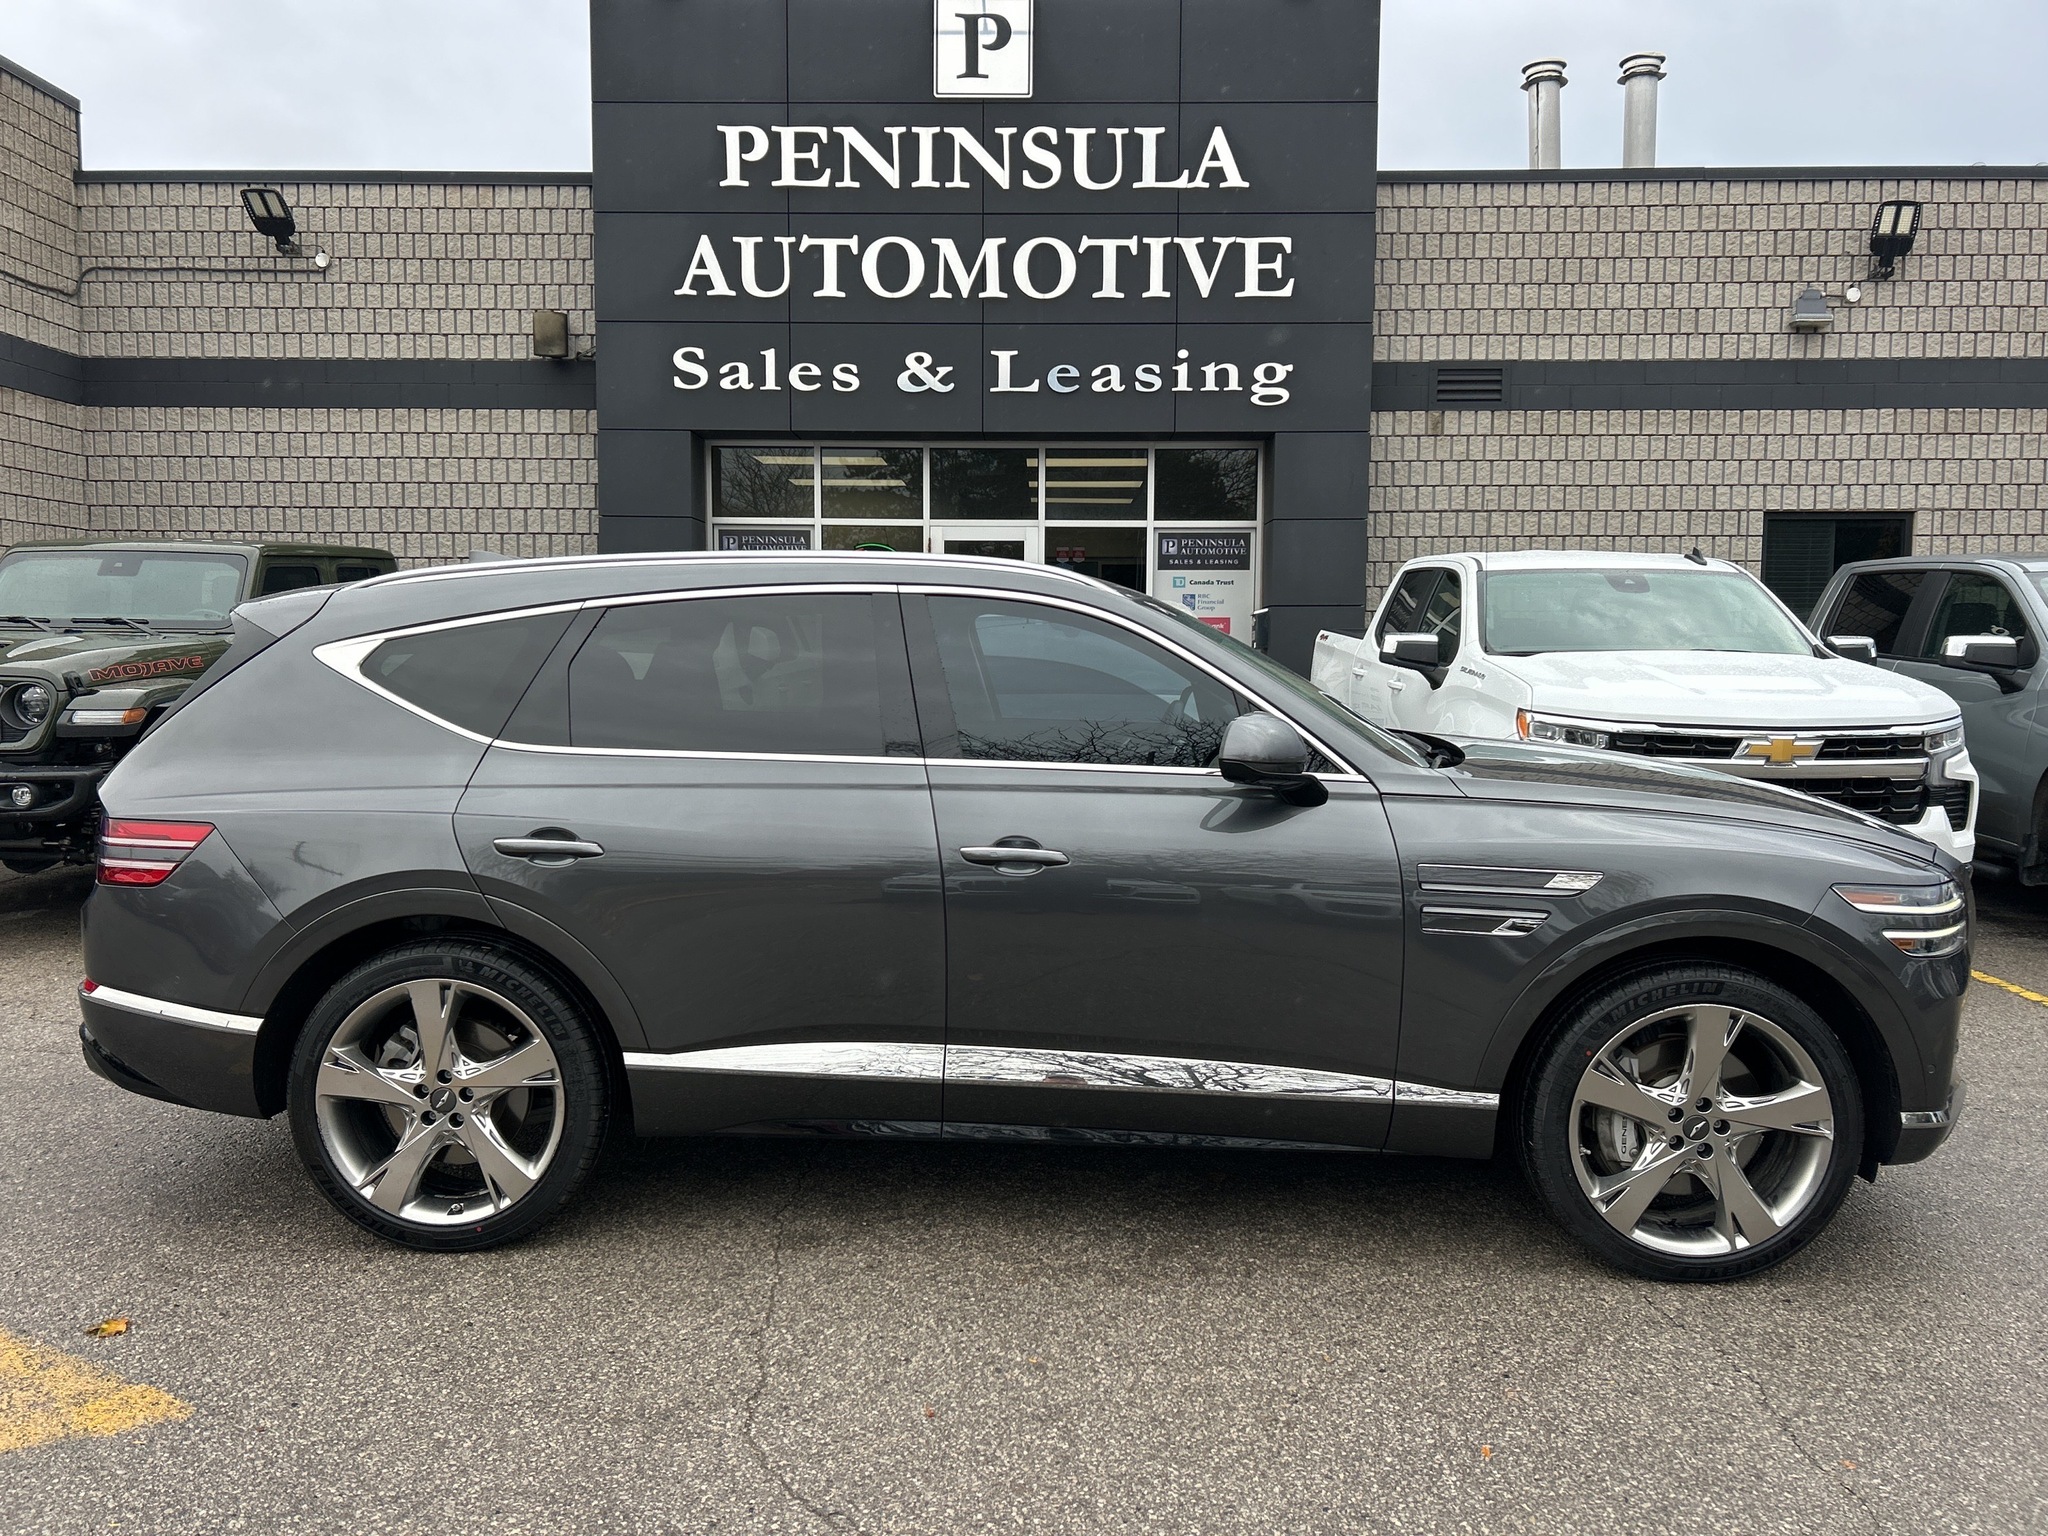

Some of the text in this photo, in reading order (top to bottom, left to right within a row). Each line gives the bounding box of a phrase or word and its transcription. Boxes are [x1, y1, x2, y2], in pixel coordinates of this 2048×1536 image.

[955, 13, 1013, 80] P
[716, 124, 1250, 191] PENINSULA
[673, 234, 1296, 300] AUTOMOTIVE
[672, 346, 1294, 407] Sales & Leasing
[725, 536, 737, 550] P
[741, 535, 806, 544] PENINSULA
[1164, 540, 1176, 554] P
[1180, 538, 1246, 547] PENINSULA
[1180, 547, 1247, 555] AUTOMOTIVE
[88, 656, 204, 681] MOJAVE
[479, 965, 566, 1036] MICHELIN
[1611, 981, 1719, 1021] MICHELIN
